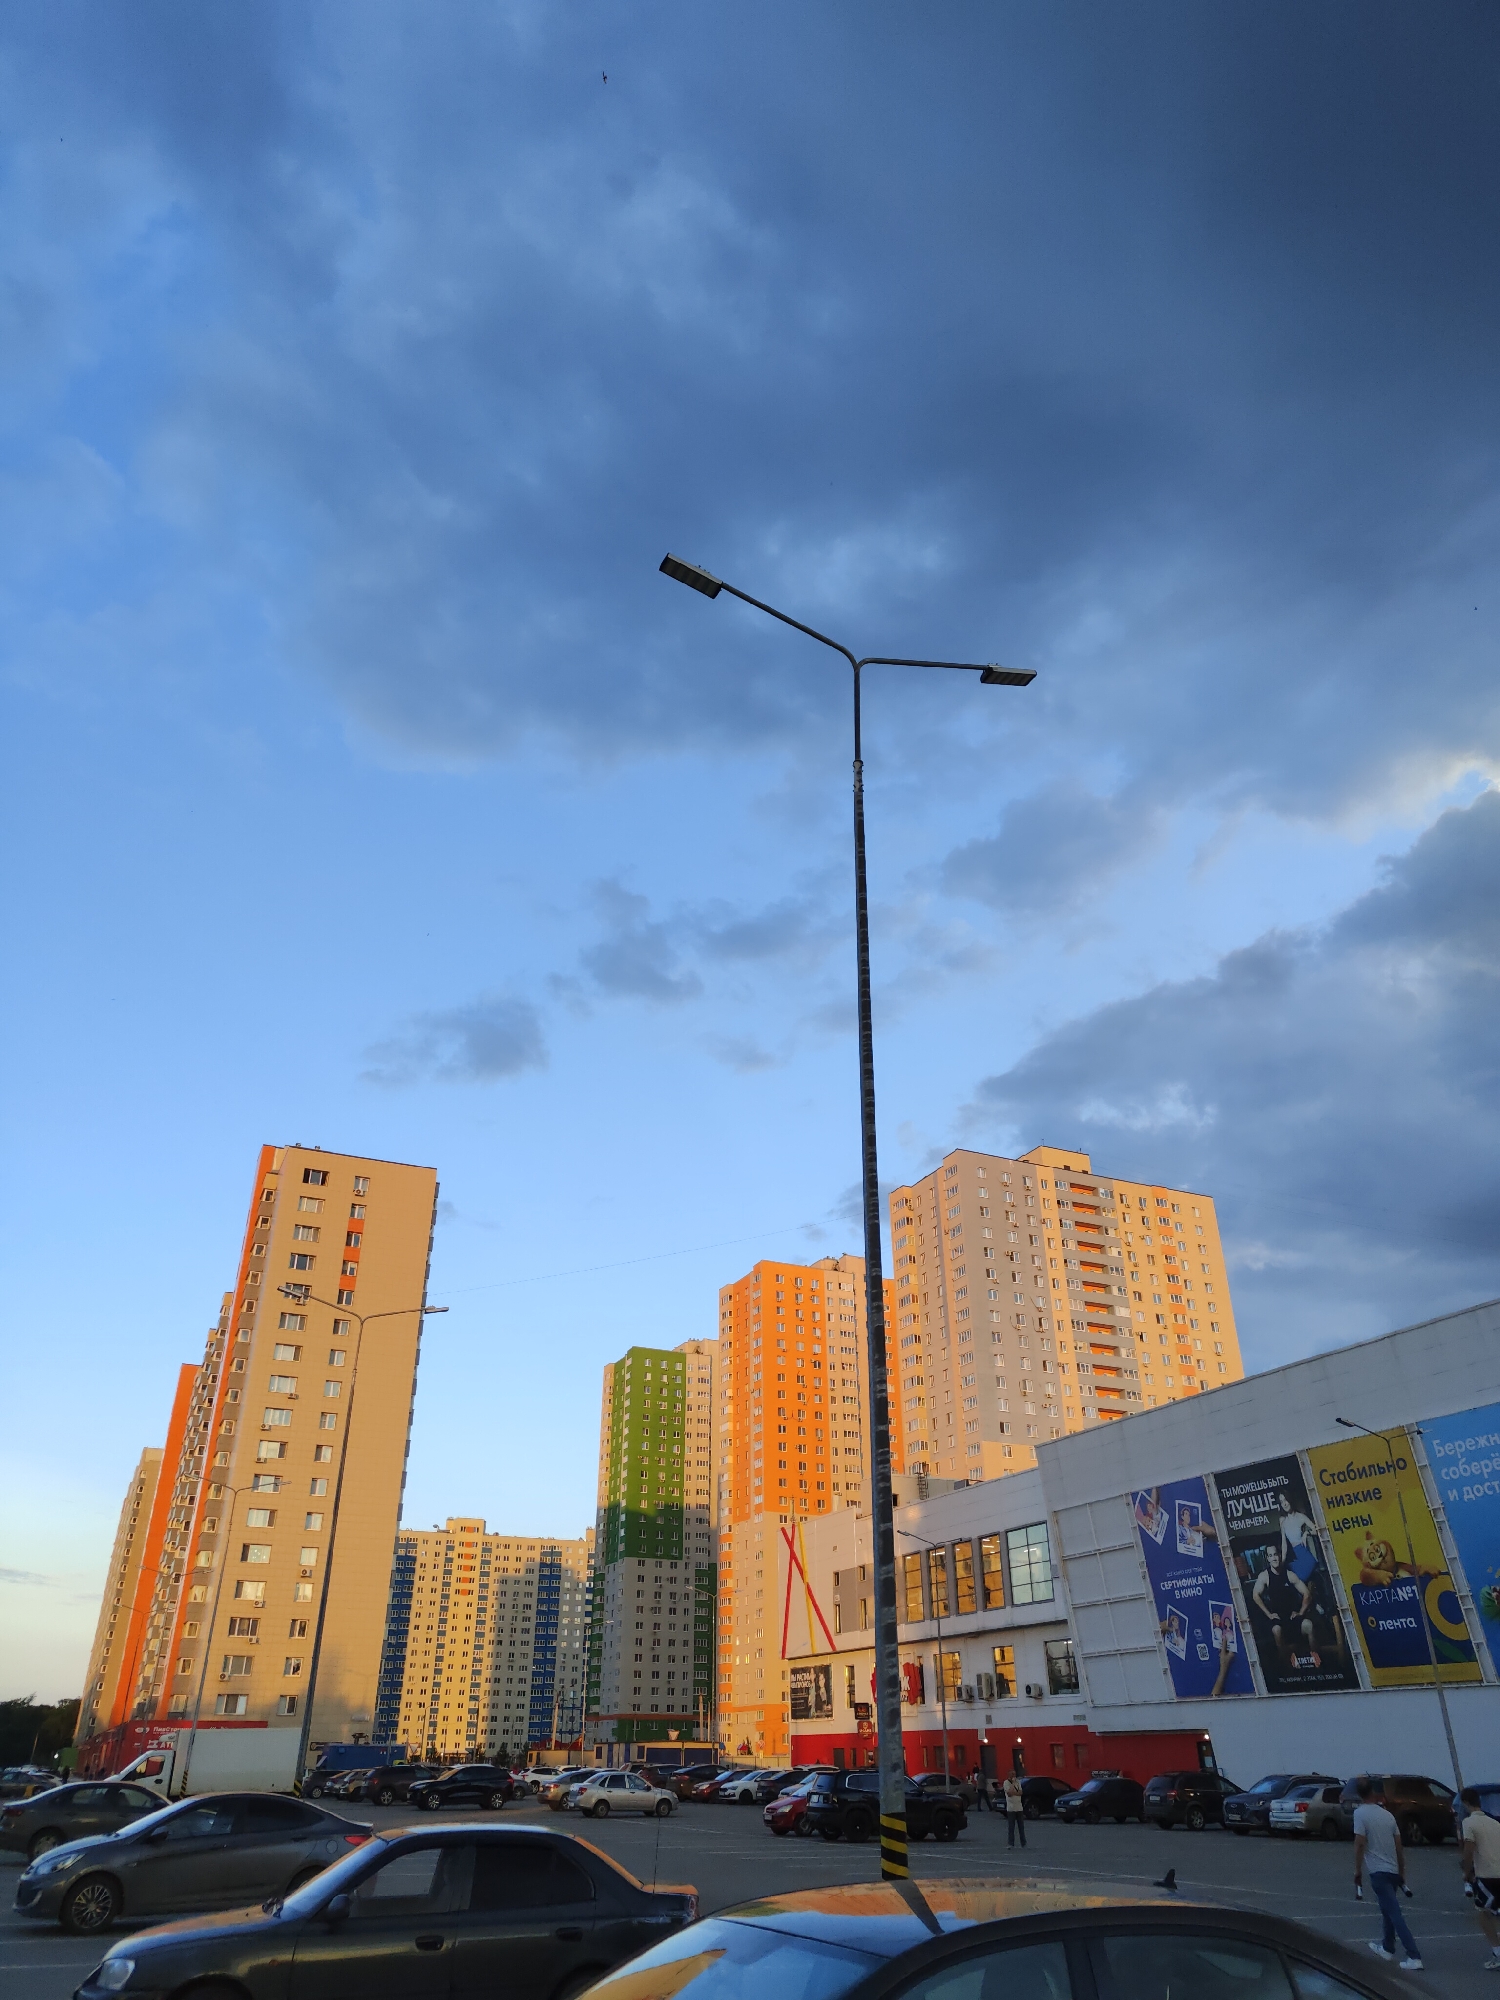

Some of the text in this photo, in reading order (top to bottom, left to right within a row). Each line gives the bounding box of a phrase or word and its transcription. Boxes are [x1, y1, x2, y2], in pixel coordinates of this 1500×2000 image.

[1319, 1457, 1407, 1487] Стабильно
[1221, 1475, 1289, 1499] ТЫ МОЖЕШЬ БЫТЬ
[1447, 1489, 1459, 1501] и
[1226, 1491, 1280, 1519] ЛУЧШЕ,
[1325, 1487, 1382, 1509] низкие
[1229, 1515, 1270, 1531] ЧЕМ ВЧЕРА
[1332, 1513, 1373, 1534] цены
[1160, 1574, 1215, 1591] СЕРТИФИКАТЫ
[1174, 1586, 1203, 1599] В КИНО
[1378, 1617, 1417, 1631] лента
